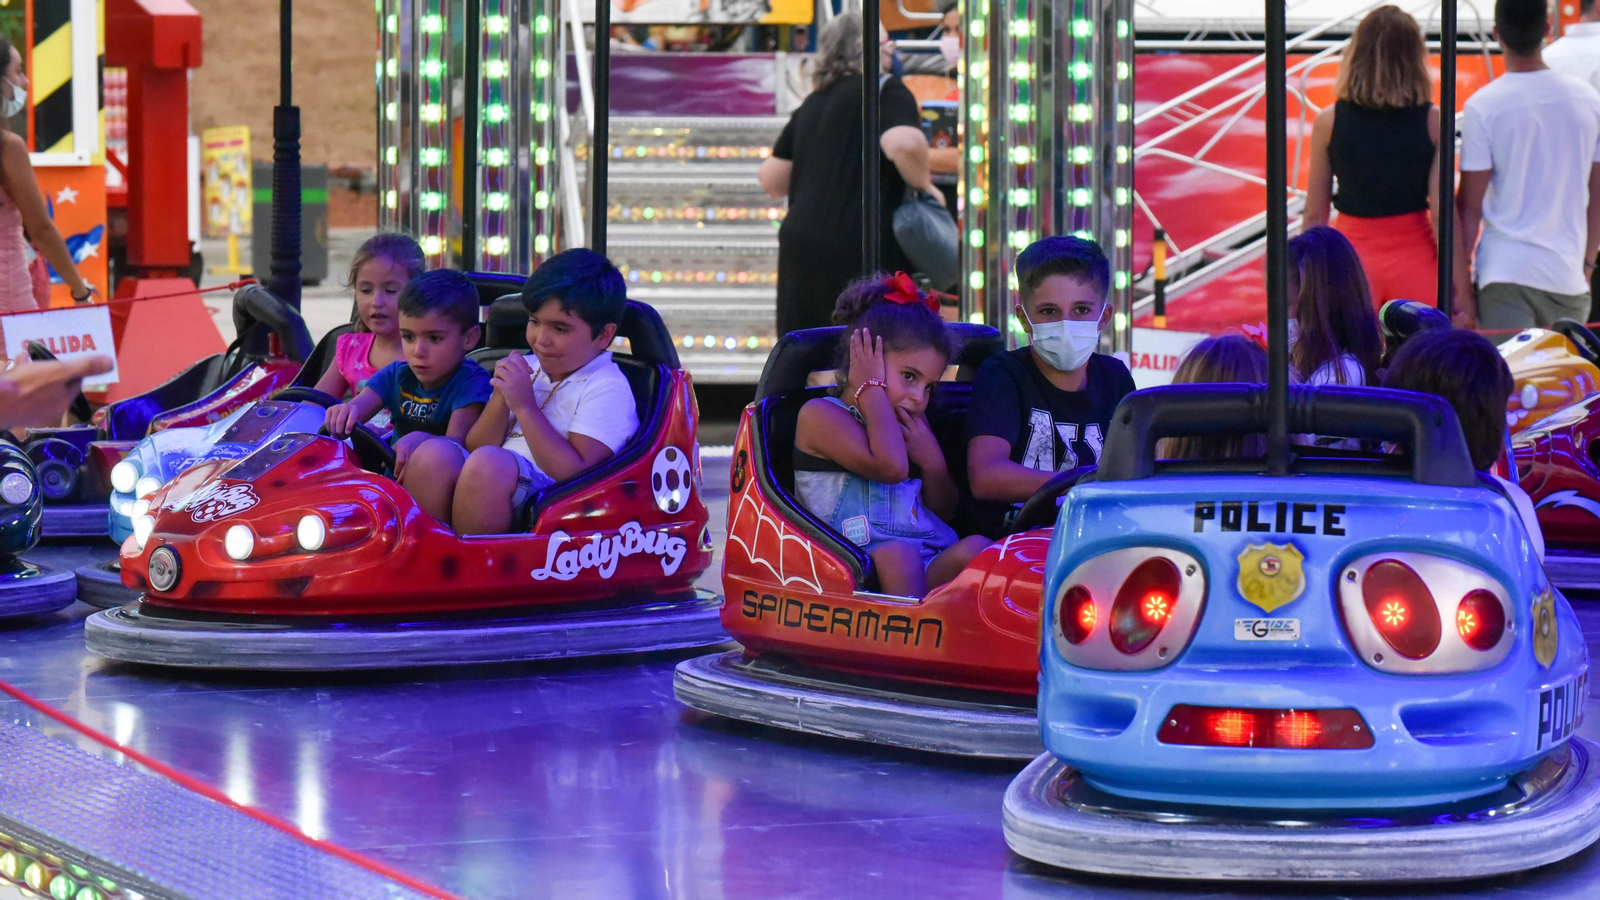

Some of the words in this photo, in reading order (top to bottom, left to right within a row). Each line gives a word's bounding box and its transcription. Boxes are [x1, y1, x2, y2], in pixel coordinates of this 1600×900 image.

[1131, 352, 1180, 371] SALID
[1193, 500, 1346, 536] POLICE
[531, 521, 687, 581] LadyBug
[742, 590, 943, 648] SPIDERMAN
